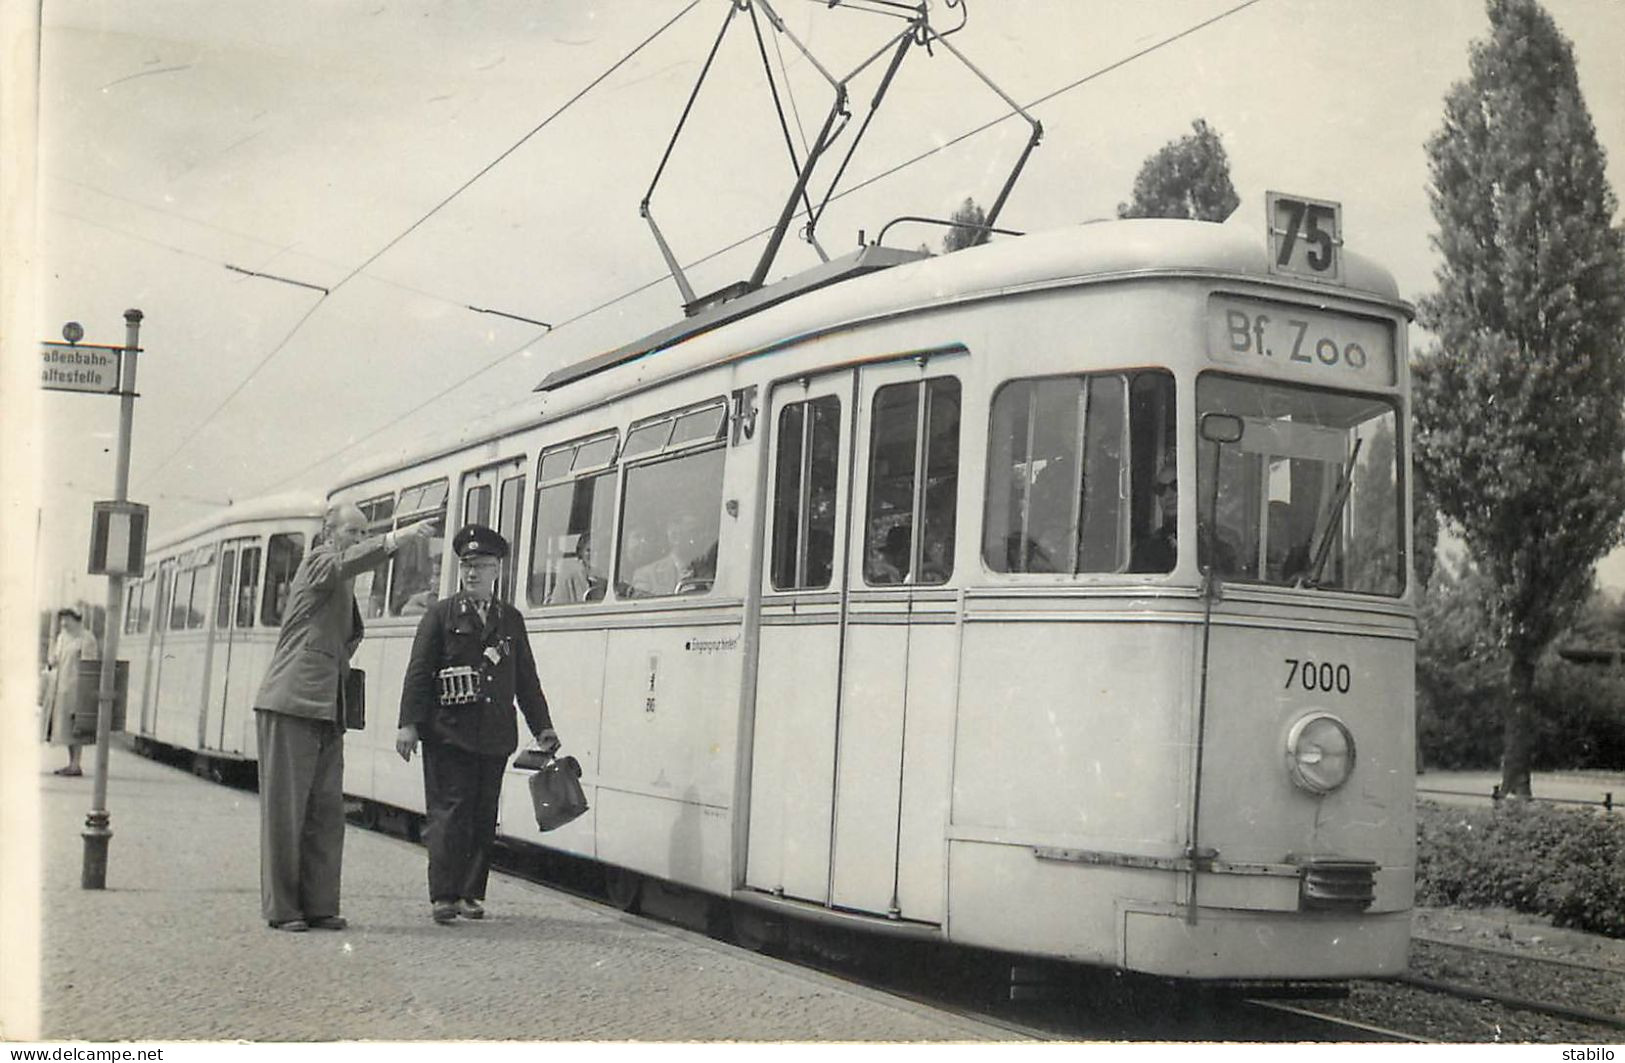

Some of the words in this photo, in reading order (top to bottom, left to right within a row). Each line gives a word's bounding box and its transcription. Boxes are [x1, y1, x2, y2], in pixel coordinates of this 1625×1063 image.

[1275, 198, 1335, 271] 75
[1226, 309, 1272, 357] Bf.
[1287, 319, 1367, 369] Zoo
[41, 368, 102, 385] altestelle
[1285, 659, 1350, 694] 7000
